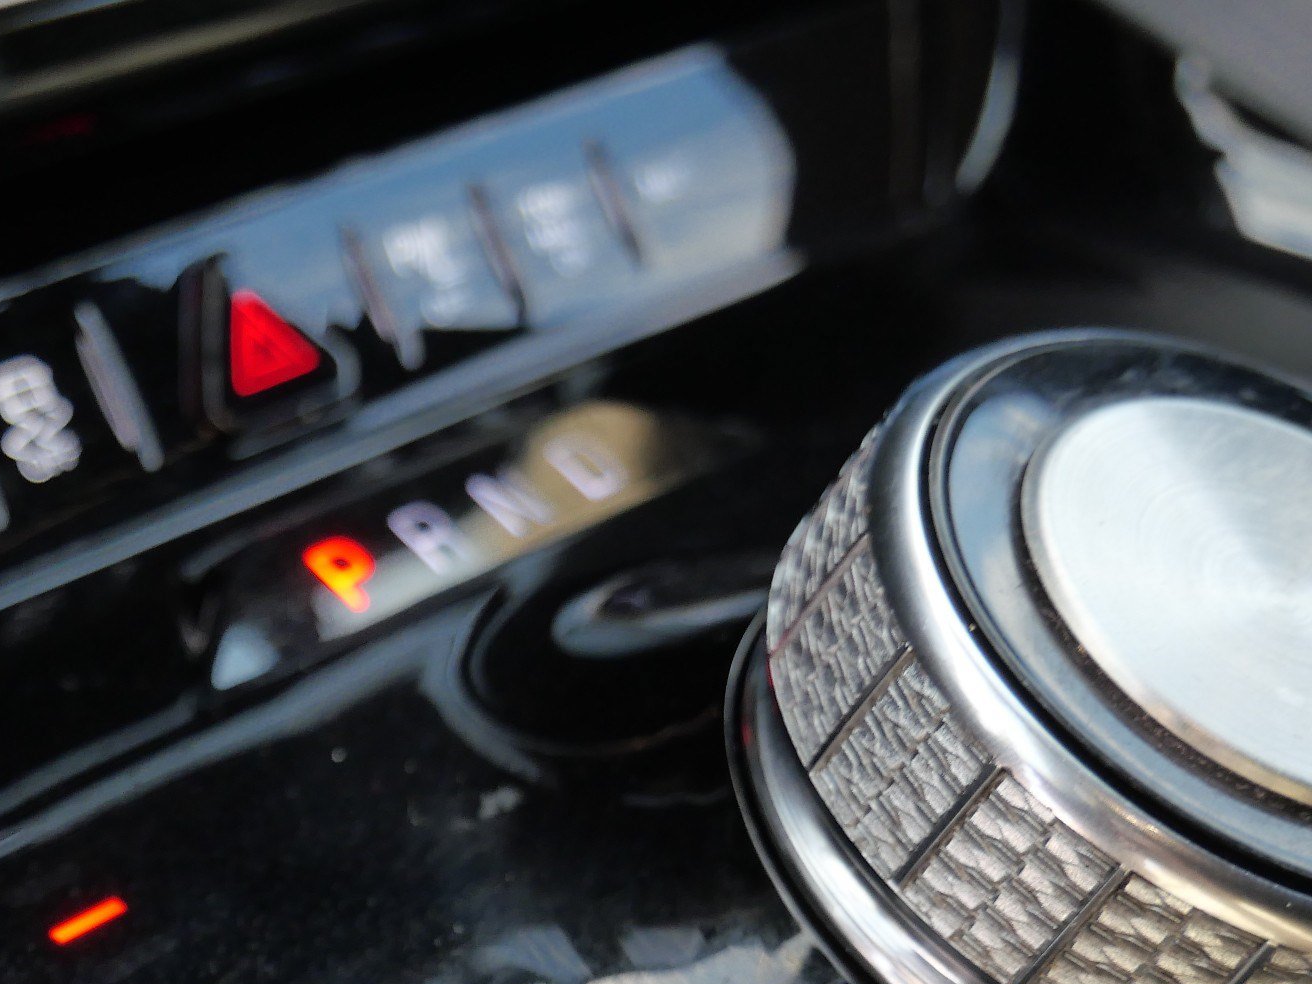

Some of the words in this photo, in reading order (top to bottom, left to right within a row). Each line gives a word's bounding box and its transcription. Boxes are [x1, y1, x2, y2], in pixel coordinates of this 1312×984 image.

[303, 536, 375, 613] P
[387, 501, 470, 576] R
[464, 472, 558, 538] N
[543, 436, 630, 500] D
